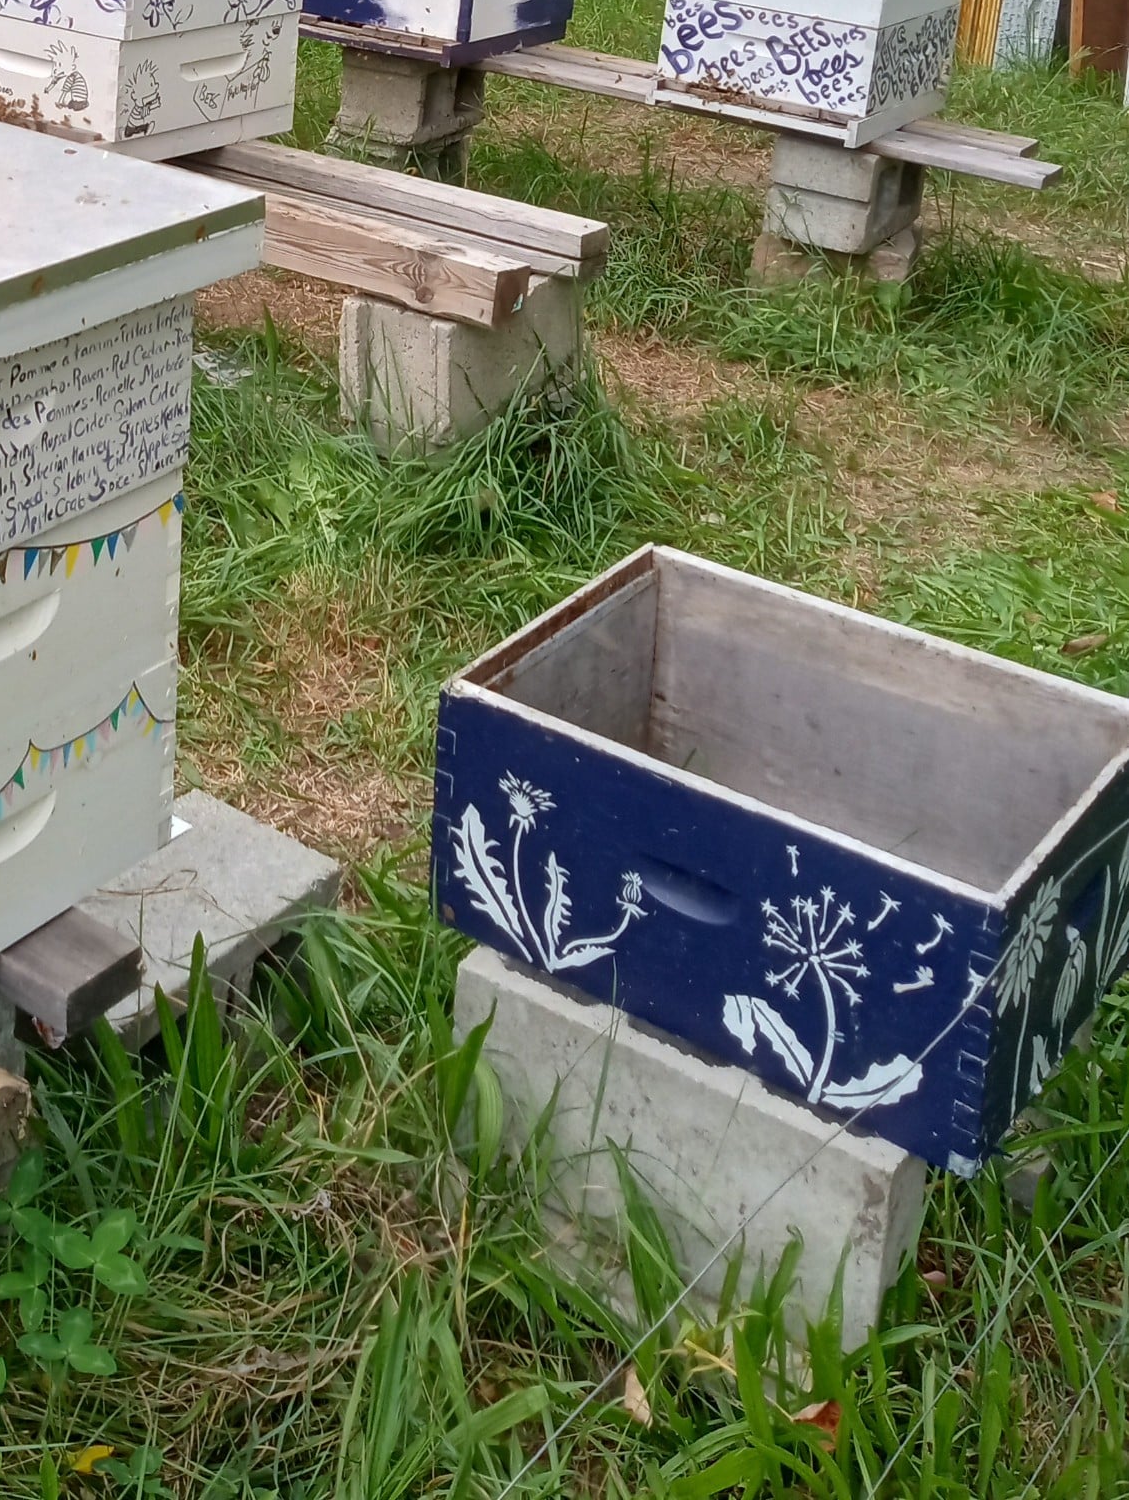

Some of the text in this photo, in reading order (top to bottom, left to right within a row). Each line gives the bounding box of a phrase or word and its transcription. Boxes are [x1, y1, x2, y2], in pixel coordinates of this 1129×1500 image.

[739, 7, 800, 29] bees
[662, 0, 743, 74] bees
[766, 21, 831, 75] BEES
[831, 25, 867, 49] bees
[795, 71, 854, 105] bees
[827, 85, 867, 111] bees
